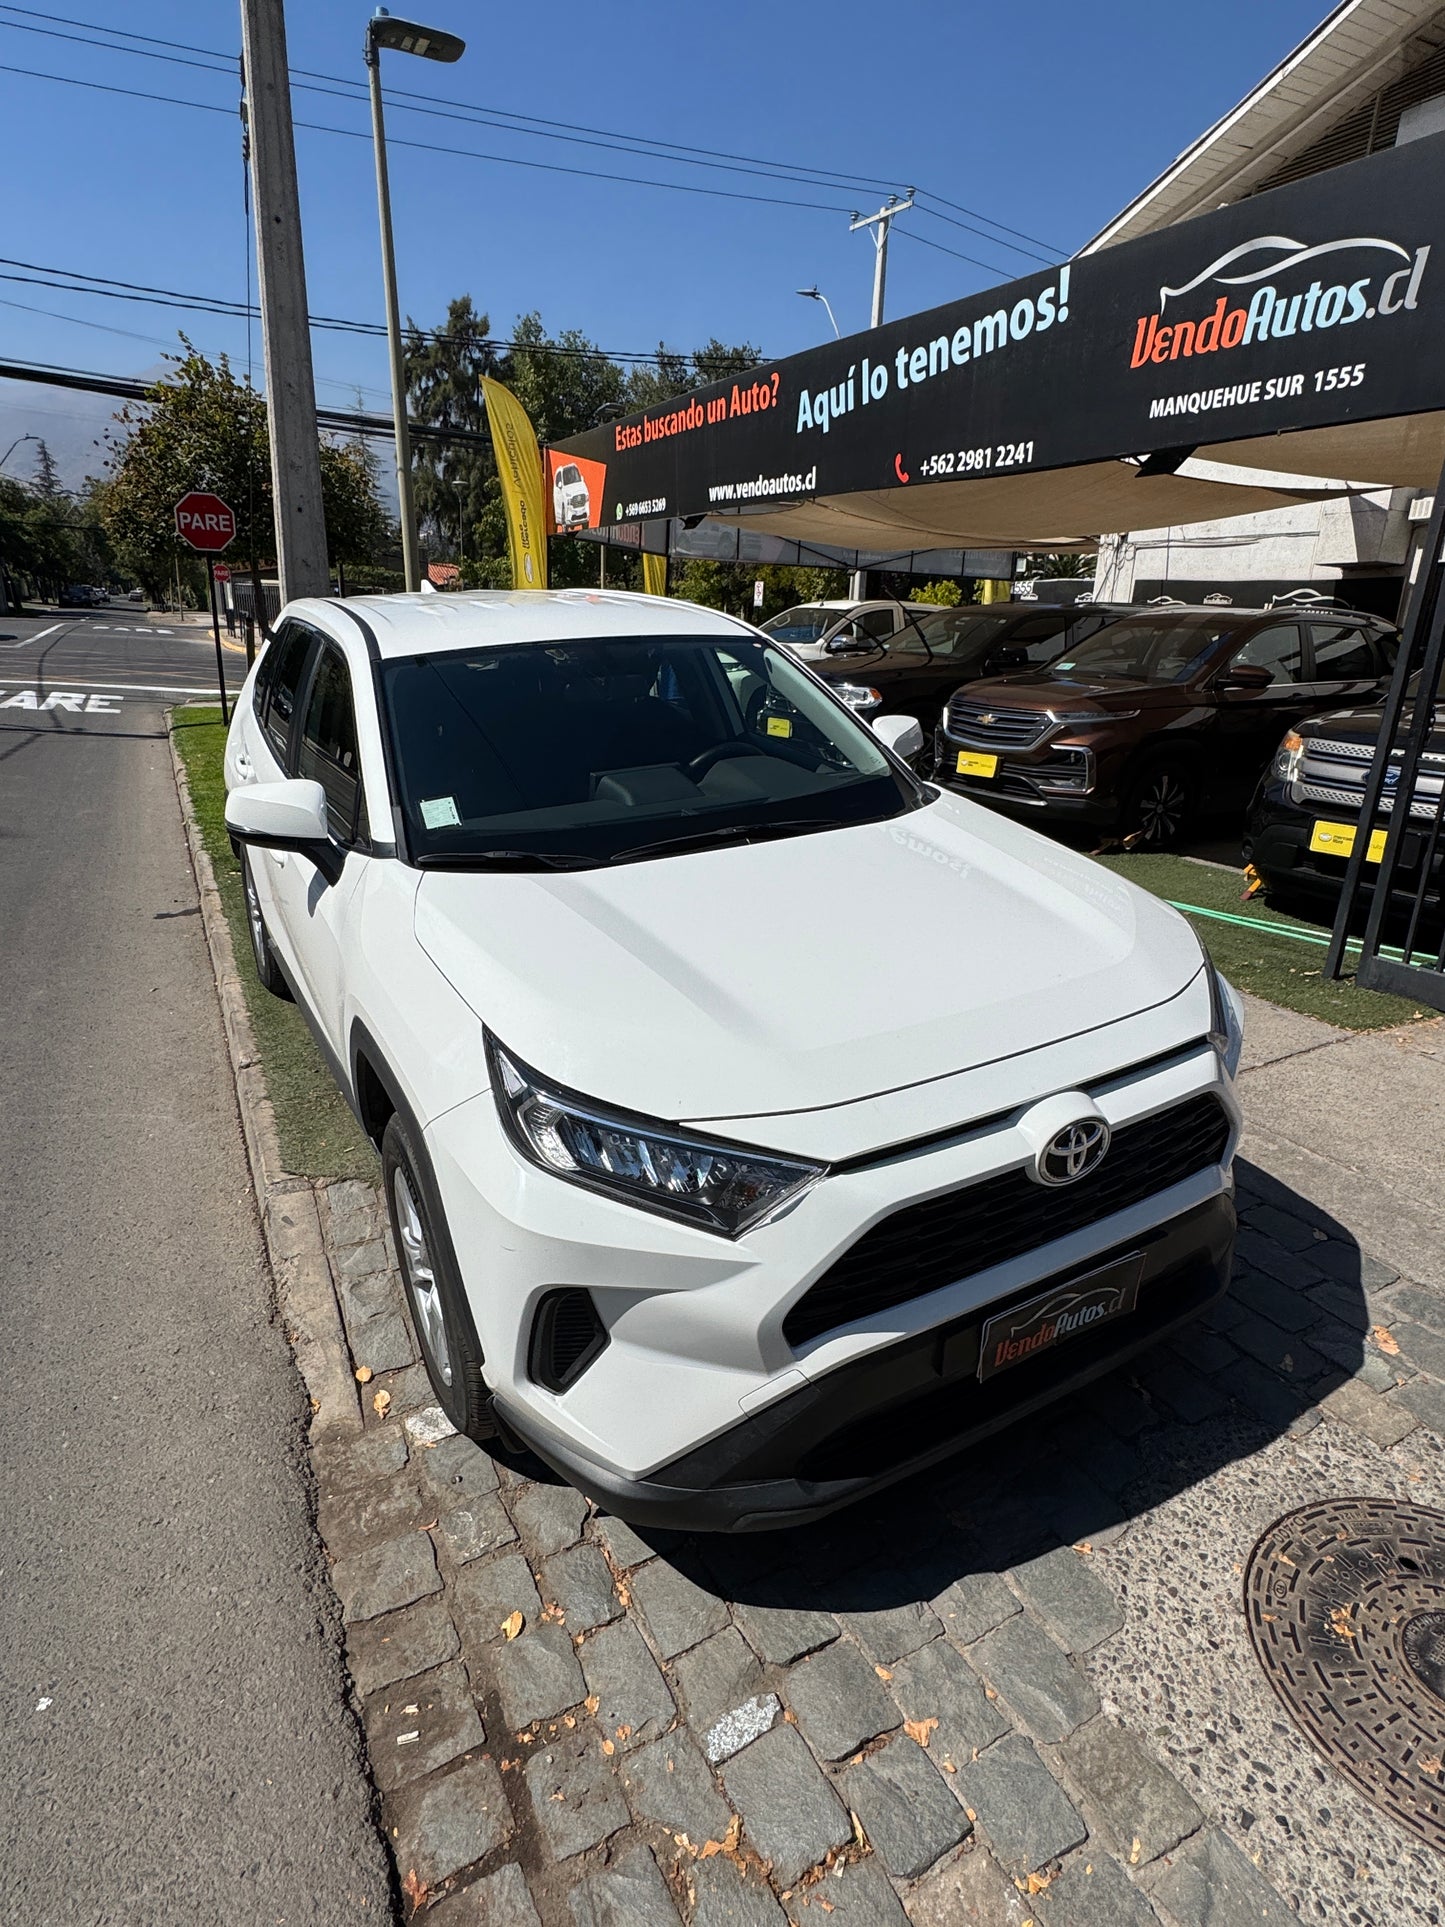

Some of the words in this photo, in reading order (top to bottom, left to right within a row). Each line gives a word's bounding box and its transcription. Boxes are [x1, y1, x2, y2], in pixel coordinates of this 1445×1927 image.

[1130, 245, 1431, 369] VendoAutos.cl
[797, 364, 856, 434] Aquí
[862, 358, 888, 405] lo
[895, 264, 1071, 390] tenemos!
[615, 424, 642, 451] Estas
[643, 398, 704, 442] buscando
[707, 397, 726, 423] un
[730, 372, 780, 418] Auto?
[1149, 381, 1262, 419] MANQUEHUE
[1264, 374, 1304, 401] SUR
[1314, 363, 1366, 392] 1555
[708, 465, 817, 502] www.vendoautos.cl
[920, 453, 954, 476] +562
[957, 447, 991, 473] 2981
[996, 441, 1034, 466] 2241
[179, 512, 231, 532] PARE
[0, 690, 124, 714] ARE
[993, 1287, 1126, 1368] VendoAutos.cl
